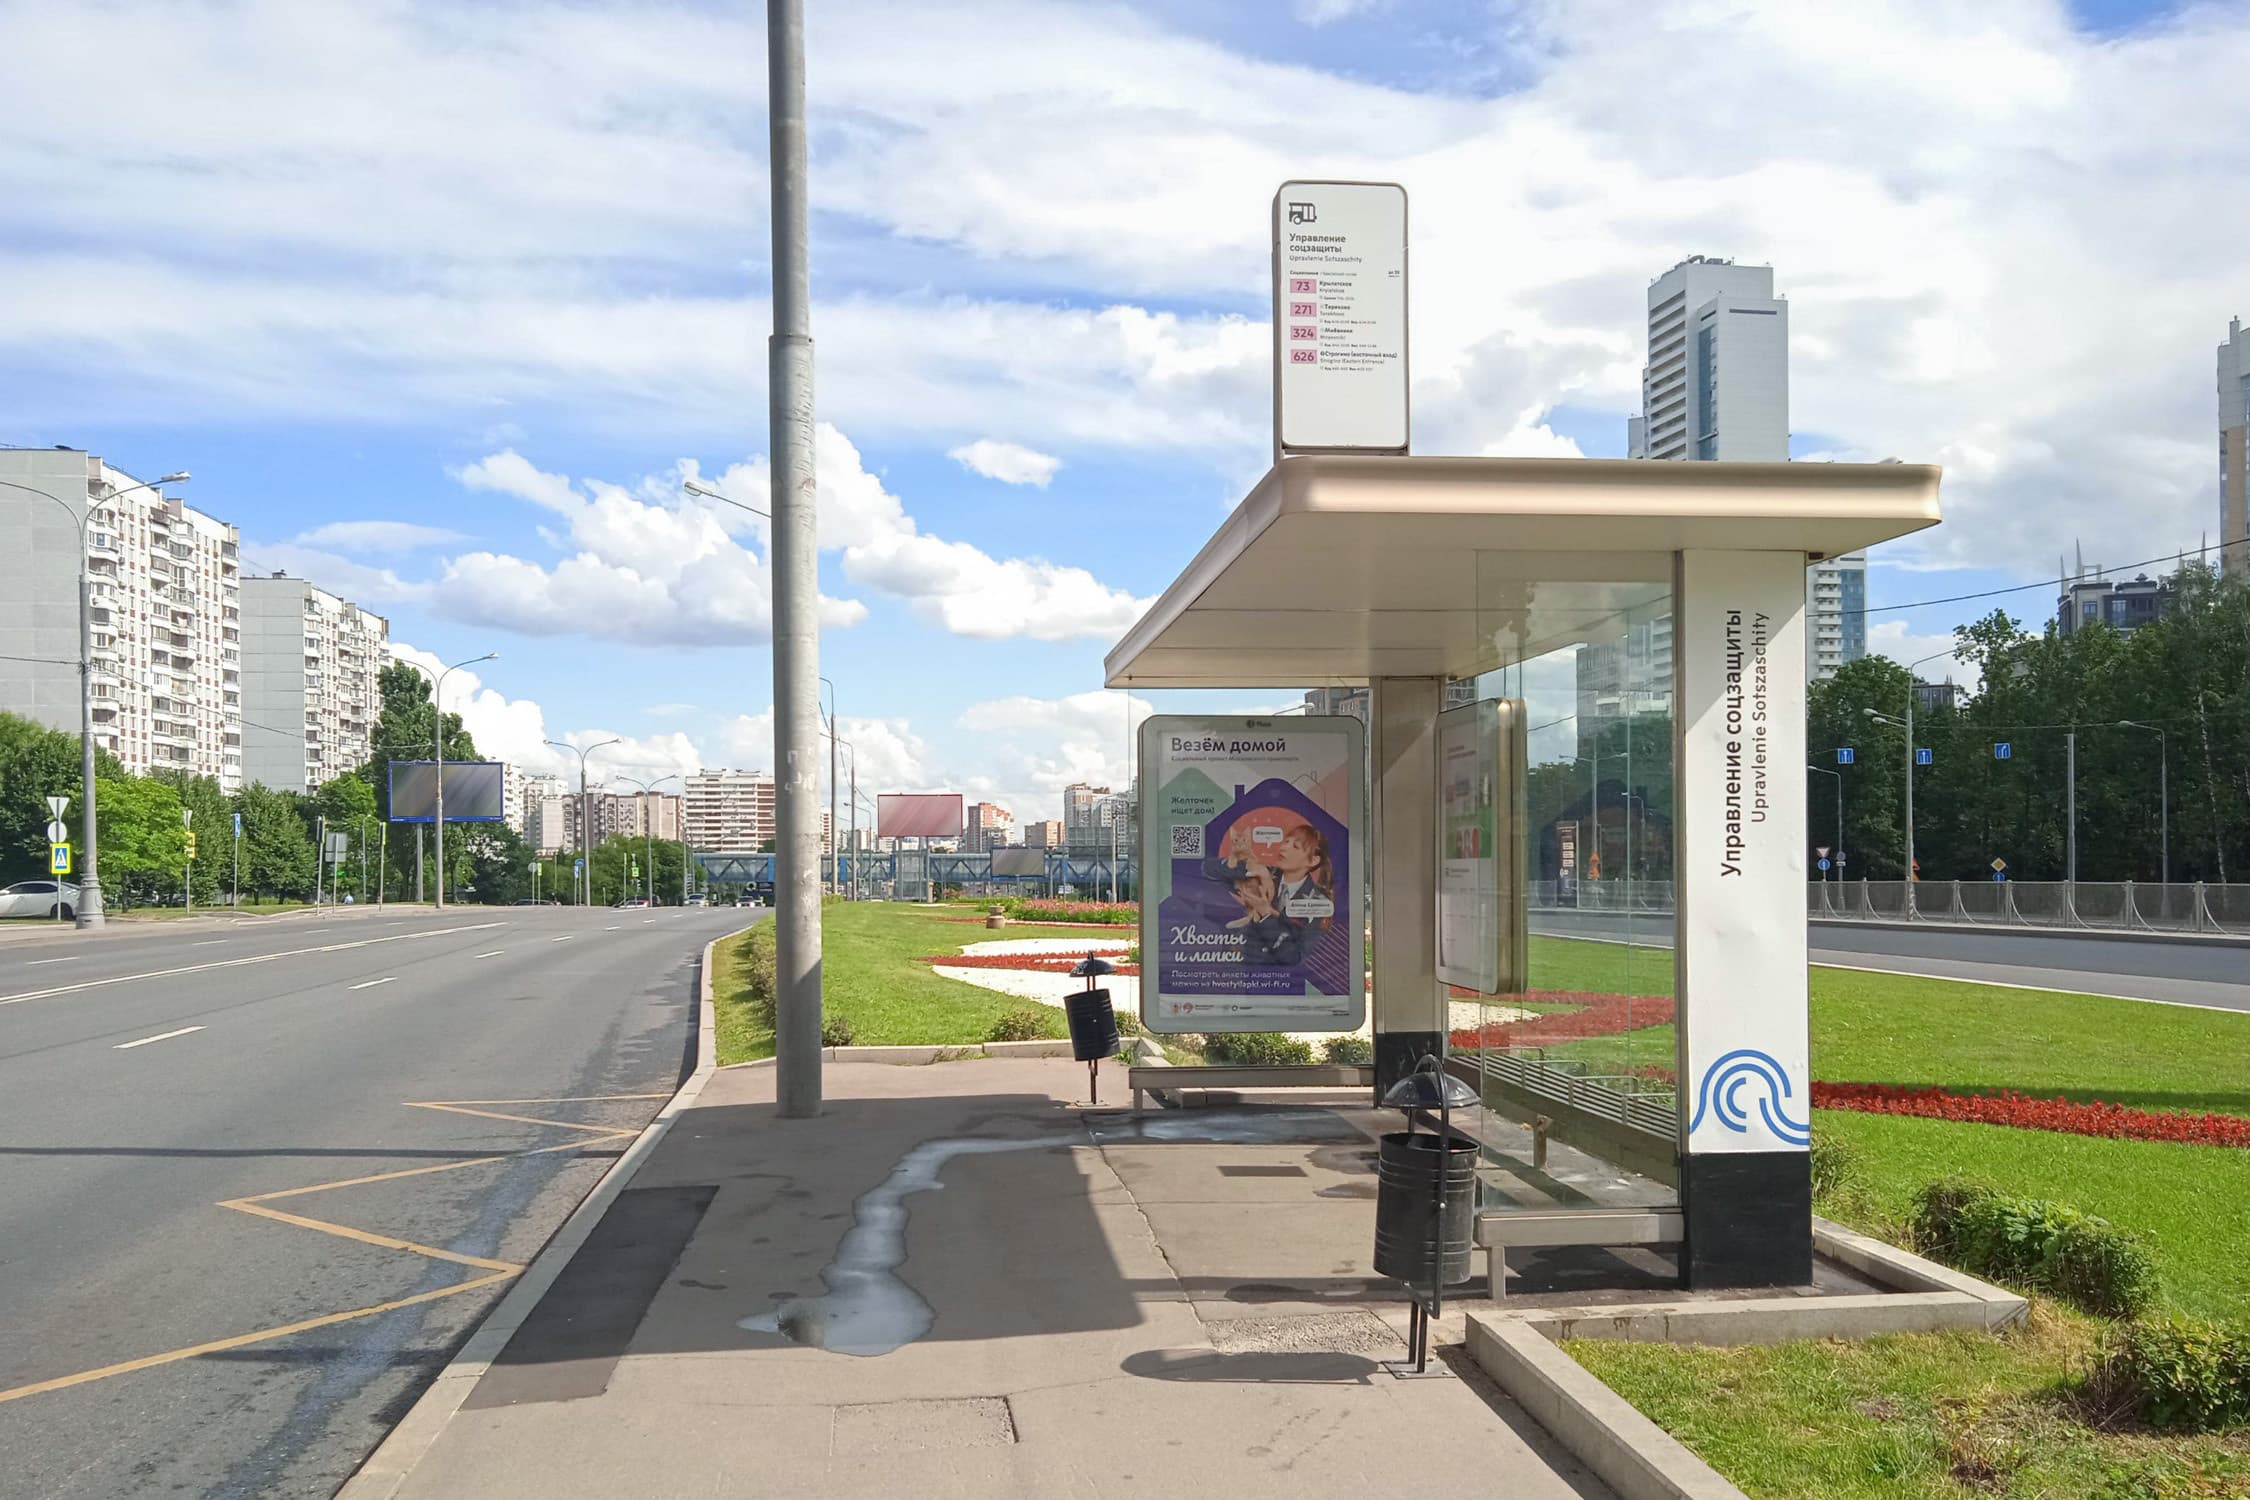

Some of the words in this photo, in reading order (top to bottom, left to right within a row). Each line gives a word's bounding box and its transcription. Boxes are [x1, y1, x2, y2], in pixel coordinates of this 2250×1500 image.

[1289, 233, 1346, 243] Управление
[1289, 244, 1342, 253] соцзащиты
[1296, 282, 1310, 291] 73
[1294, 305, 1312, 314] 271
[1293, 328, 1314, 338] 324
[1293, 352, 1314, 362] 626
[1726, 610, 1745, 735] соцзащиты
[1751, 612, 1770, 722] Sotszaschity
[1171, 737, 1225, 752] Везём
[1230, 737, 1286, 753] домой
[1751, 727, 1769, 823] Upravlenie
[1721, 741, 1745, 877] Управление
[1170, 925, 1247, 946] Хвосты
[1175, 951, 1188, 962] и
[1189, 950, 1244, 963] лапки
